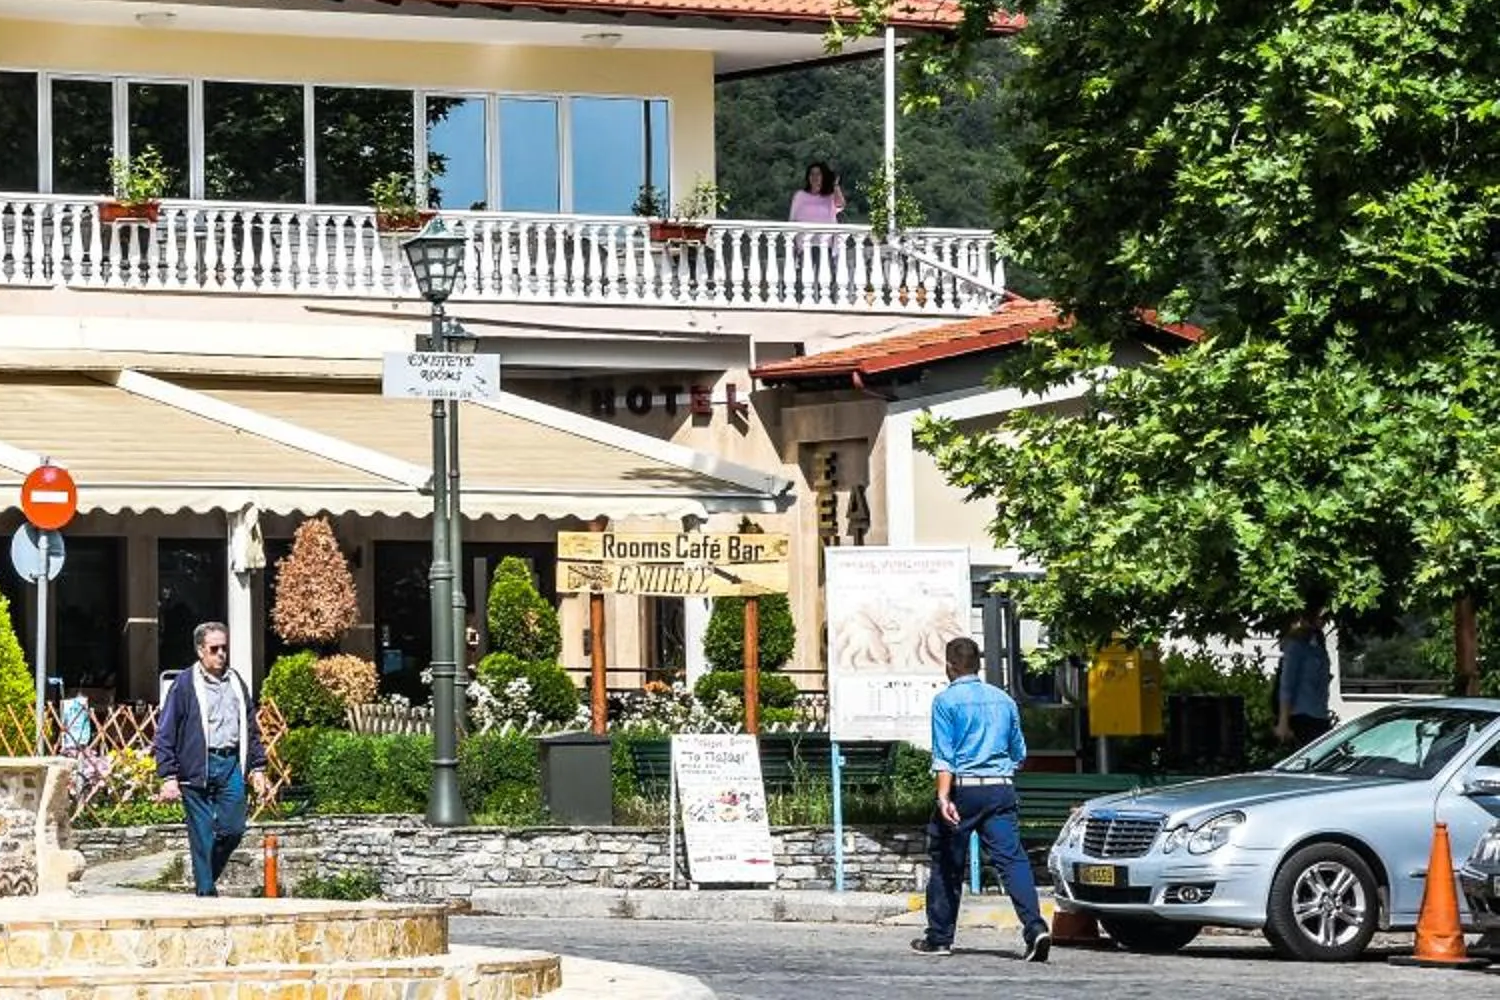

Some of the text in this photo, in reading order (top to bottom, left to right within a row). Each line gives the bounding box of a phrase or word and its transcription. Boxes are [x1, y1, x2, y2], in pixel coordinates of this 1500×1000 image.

[591, 383, 749, 417] HOTEL
[602, 533, 765, 562] Rooms Café Bar
